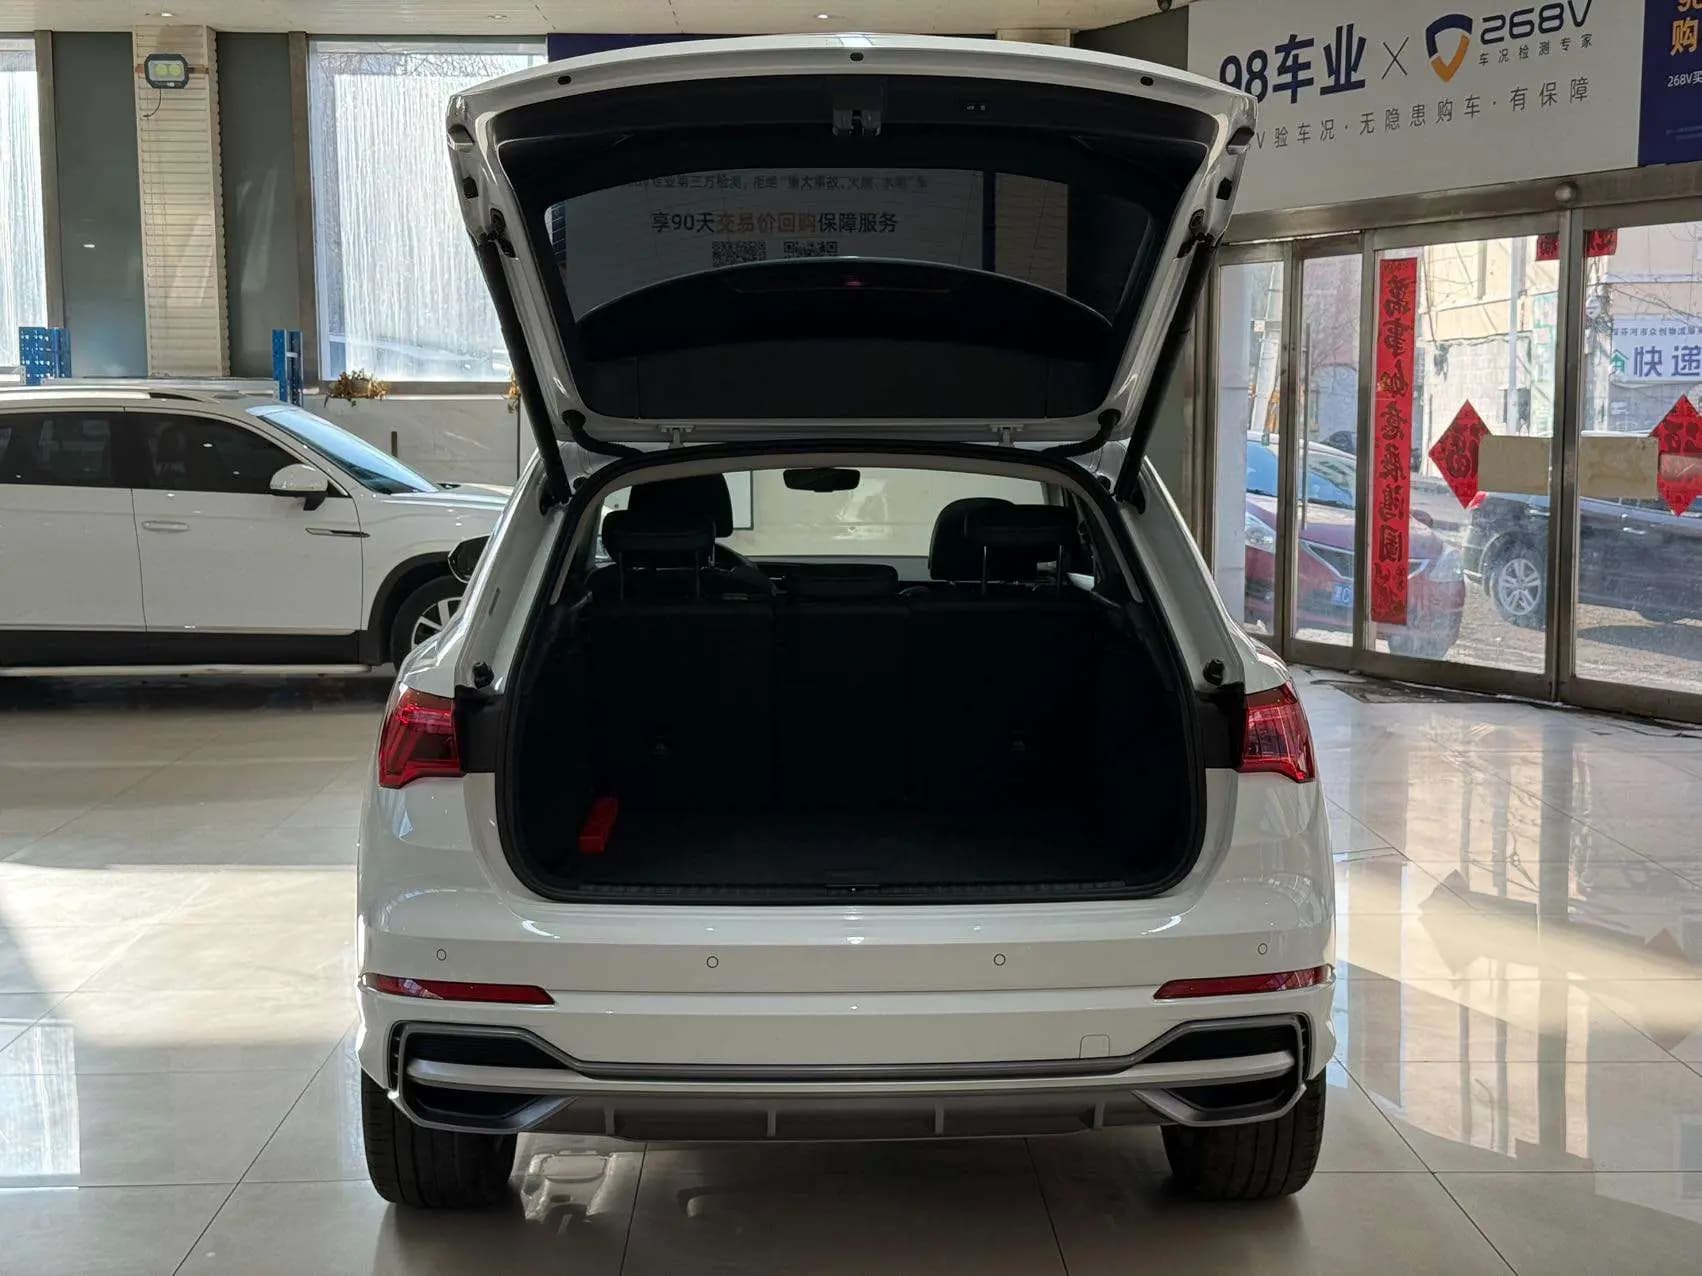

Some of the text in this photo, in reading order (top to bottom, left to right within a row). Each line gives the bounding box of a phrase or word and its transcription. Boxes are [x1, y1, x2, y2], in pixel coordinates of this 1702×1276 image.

[1219, 23, 1367, 104] 98车业
[1478, 34, 1593, 66] 车况检测专家
[1252, 76, 1590, 150] V验车况·无隐患购车·有保障
[651, 211, 899, 233] 享90天交易价回购保障服务
[1633, 345, 1702, 377] 快递
